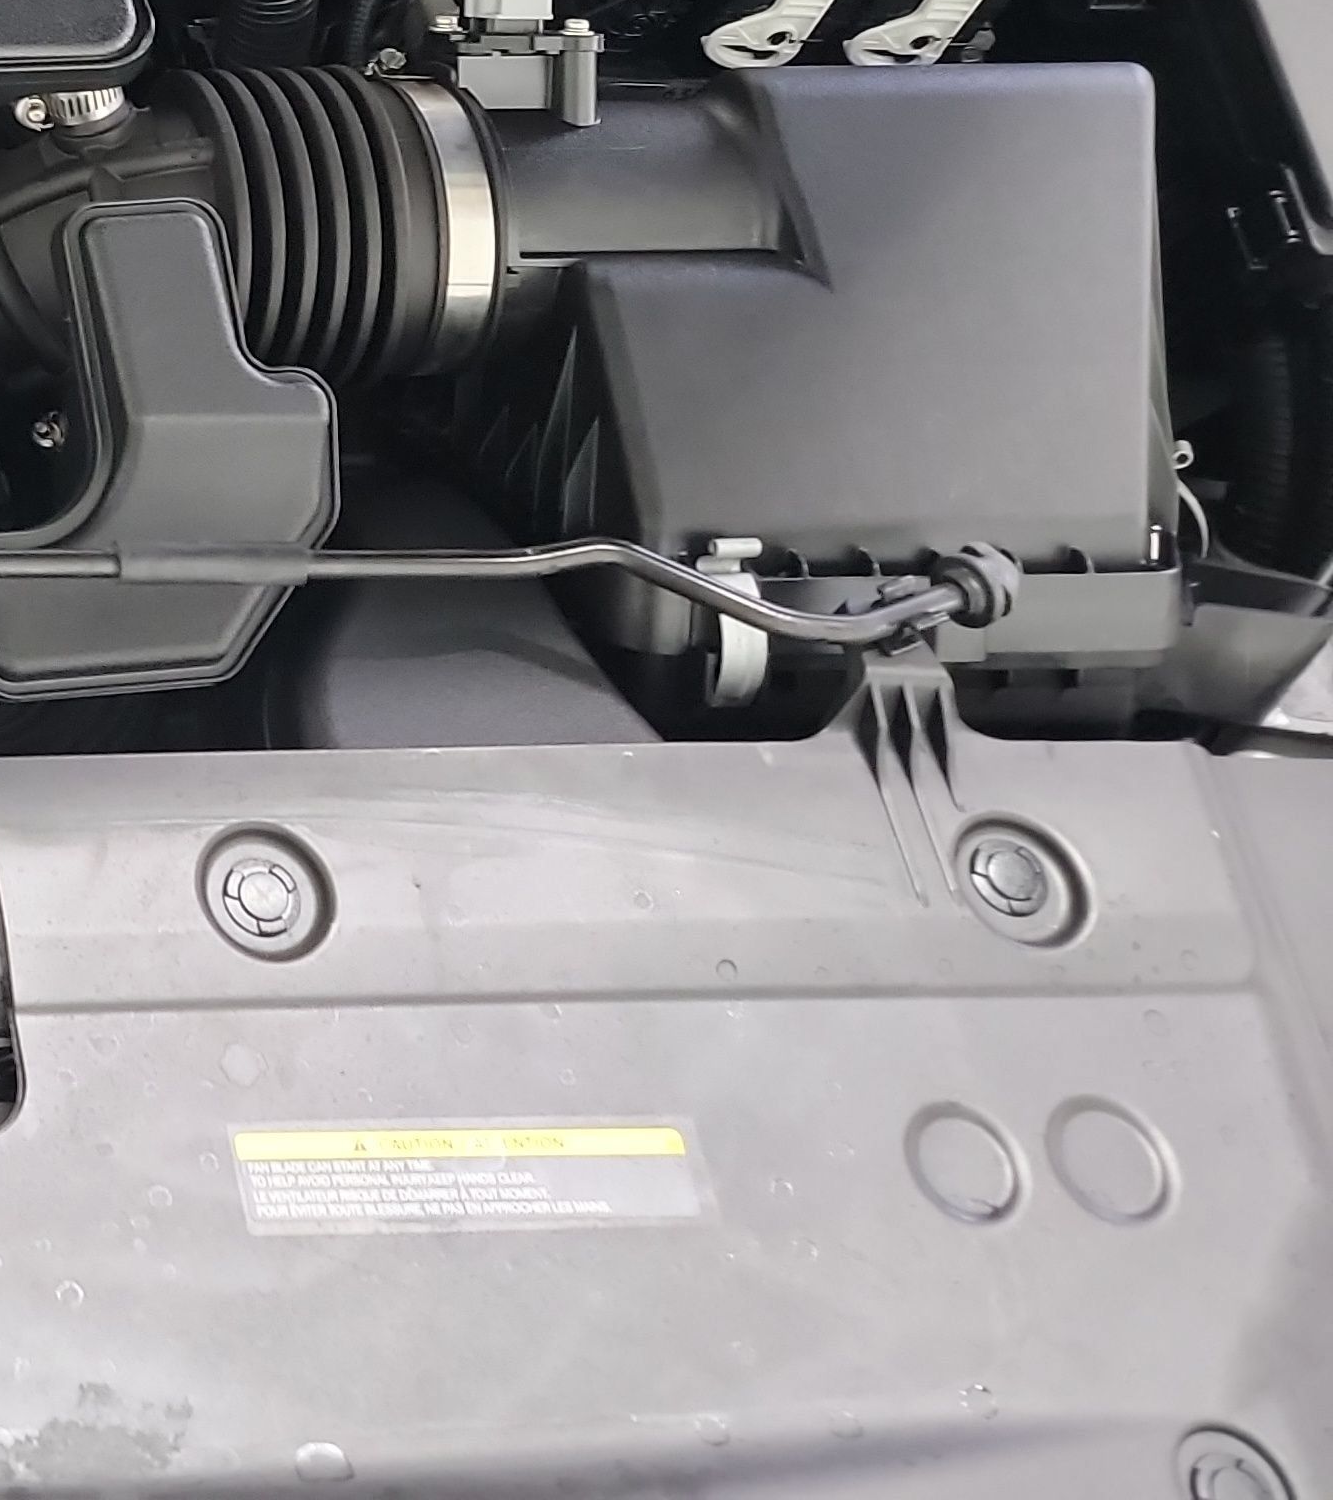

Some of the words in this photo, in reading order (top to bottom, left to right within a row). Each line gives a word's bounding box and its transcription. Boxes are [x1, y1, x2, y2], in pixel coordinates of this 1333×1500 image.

[297, 1174, 331, 1188] AVOID
[331, 1173, 390, 1187] PERSONAL
[441, 1201, 466, 1215] PAS
